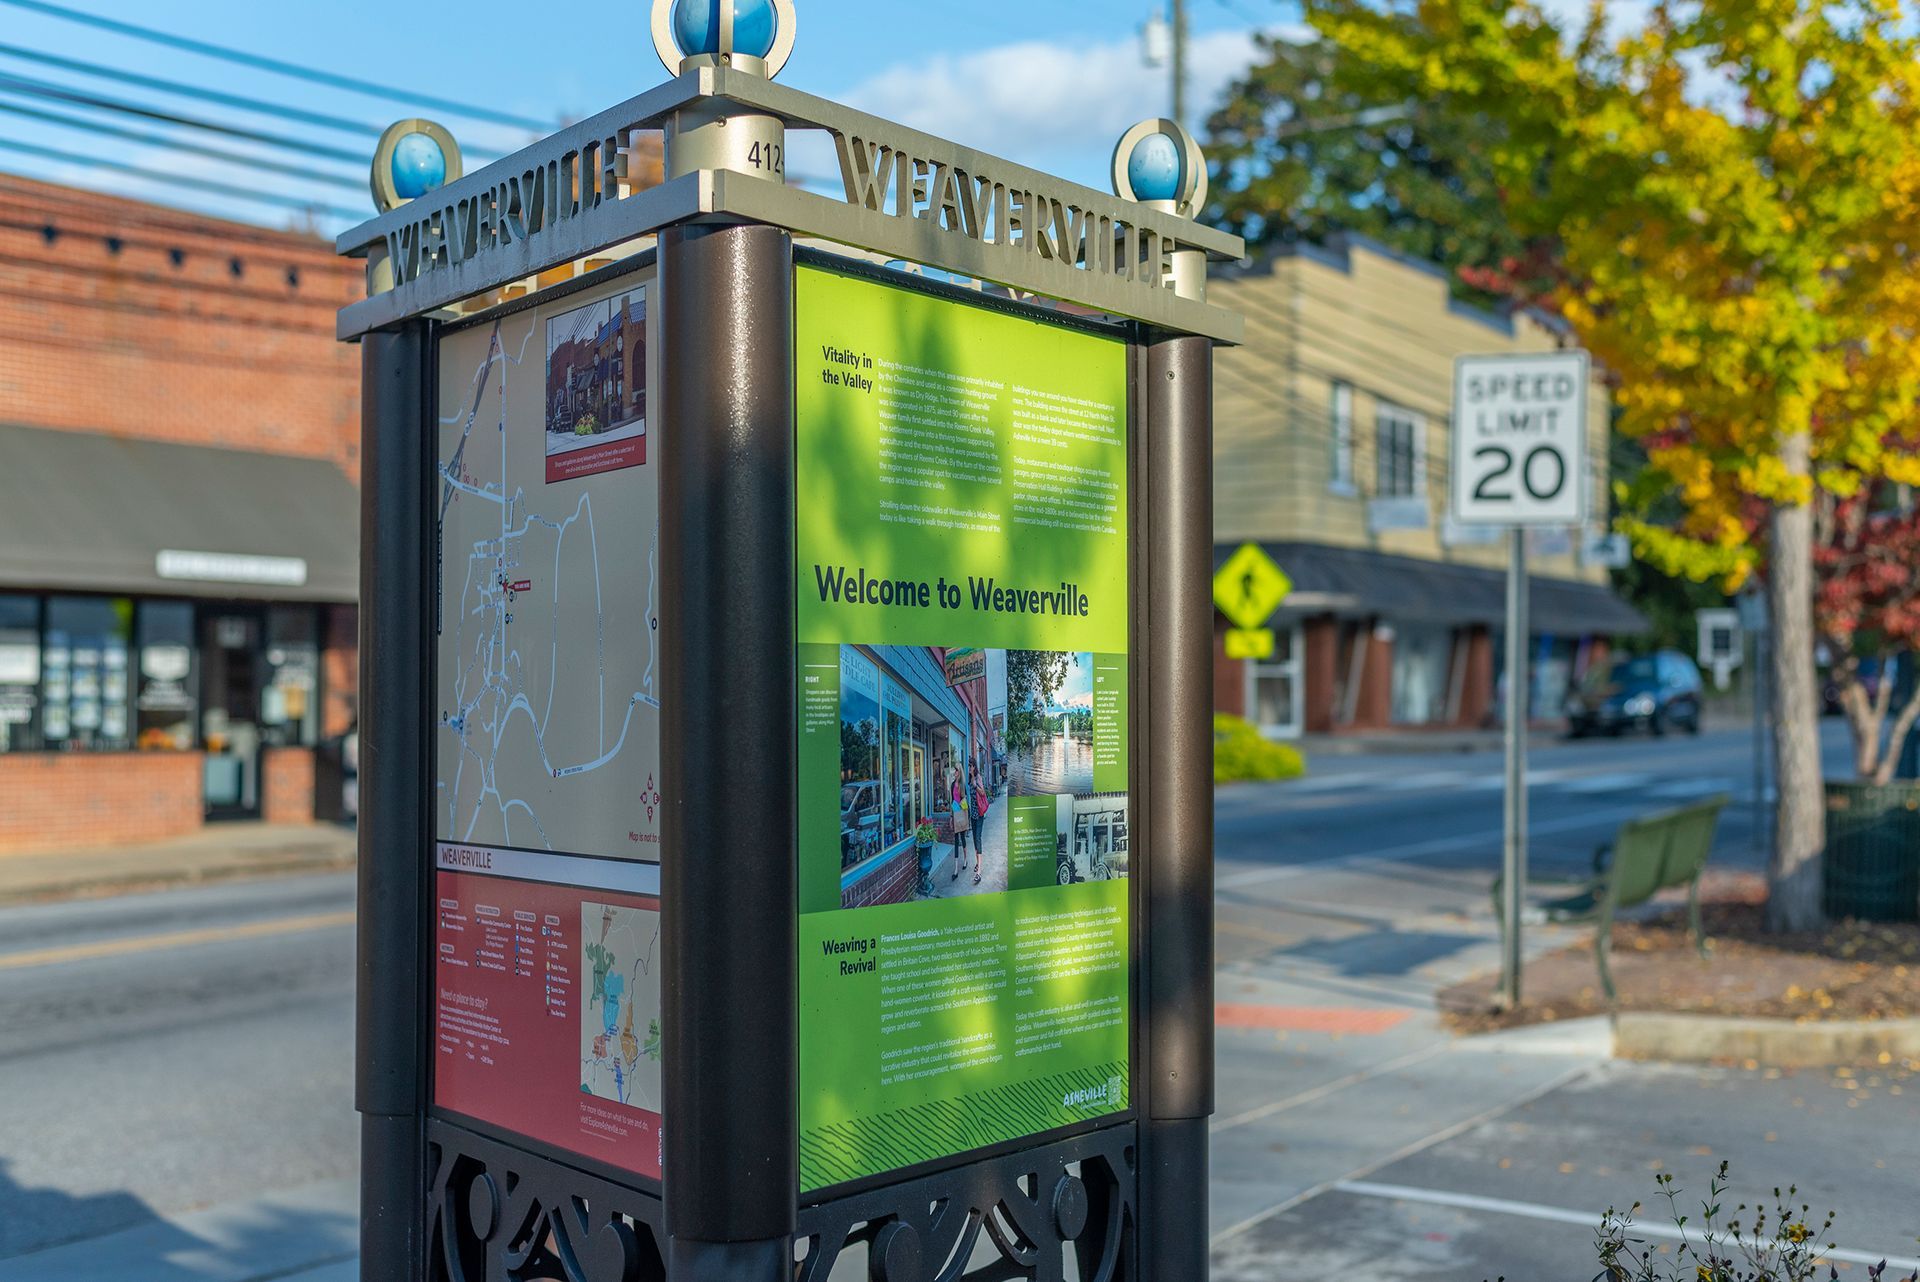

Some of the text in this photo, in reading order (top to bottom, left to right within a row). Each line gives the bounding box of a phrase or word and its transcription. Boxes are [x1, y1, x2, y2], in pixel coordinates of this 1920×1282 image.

[748, 141, 784, 174] 412
[386, 130, 631, 286] WEAVERVILLE
[833, 130, 1176, 296] WEAVERVILLE
[822, 345, 872, 370] Vitality in
[822, 368, 872, 394] the Valley
[878, 357, 894, 370] During
[903, 363, 924, 374] centuries
[924, 367, 936, 376] when
[937, 369, 945, 378] this
[965, 375, 984, 387] primarily
[984, 378, 1003, 389] inhabited
[1468, 374, 1575, 402] SPEED
[1476, 408, 1560, 435] LIMIT
[1473, 444, 1566, 501] 20
[814, 564, 1089, 616] Welcome to Weaverville
[628, 832, 638, 843] Map
[640, 833, 644, 842] is
[442, 848, 492, 869] WEAVERVILLE
[880, 934, 900, 942] Frances
[900, 930, 916, 940] Louisa
[916, 927, 939, 938] Goodrich,
[943, 923, 974, 934] Yale-educated
[974, 922, 985, 931] artist
[985, 921, 994, 929] and
[822, 936, 876, 956] Weaving a
[880, 944, 910, 956] Presbyterian
[935, 938, 950, 948] moved
[840, 956, 876, 976] Revival
[440, 988, 452, 1001] Need
[457, 993, 469, 1005] place
[475, 996, 488, 1011] stay?
[1064, 1084, 1107, 1107] ASHEVILLE
